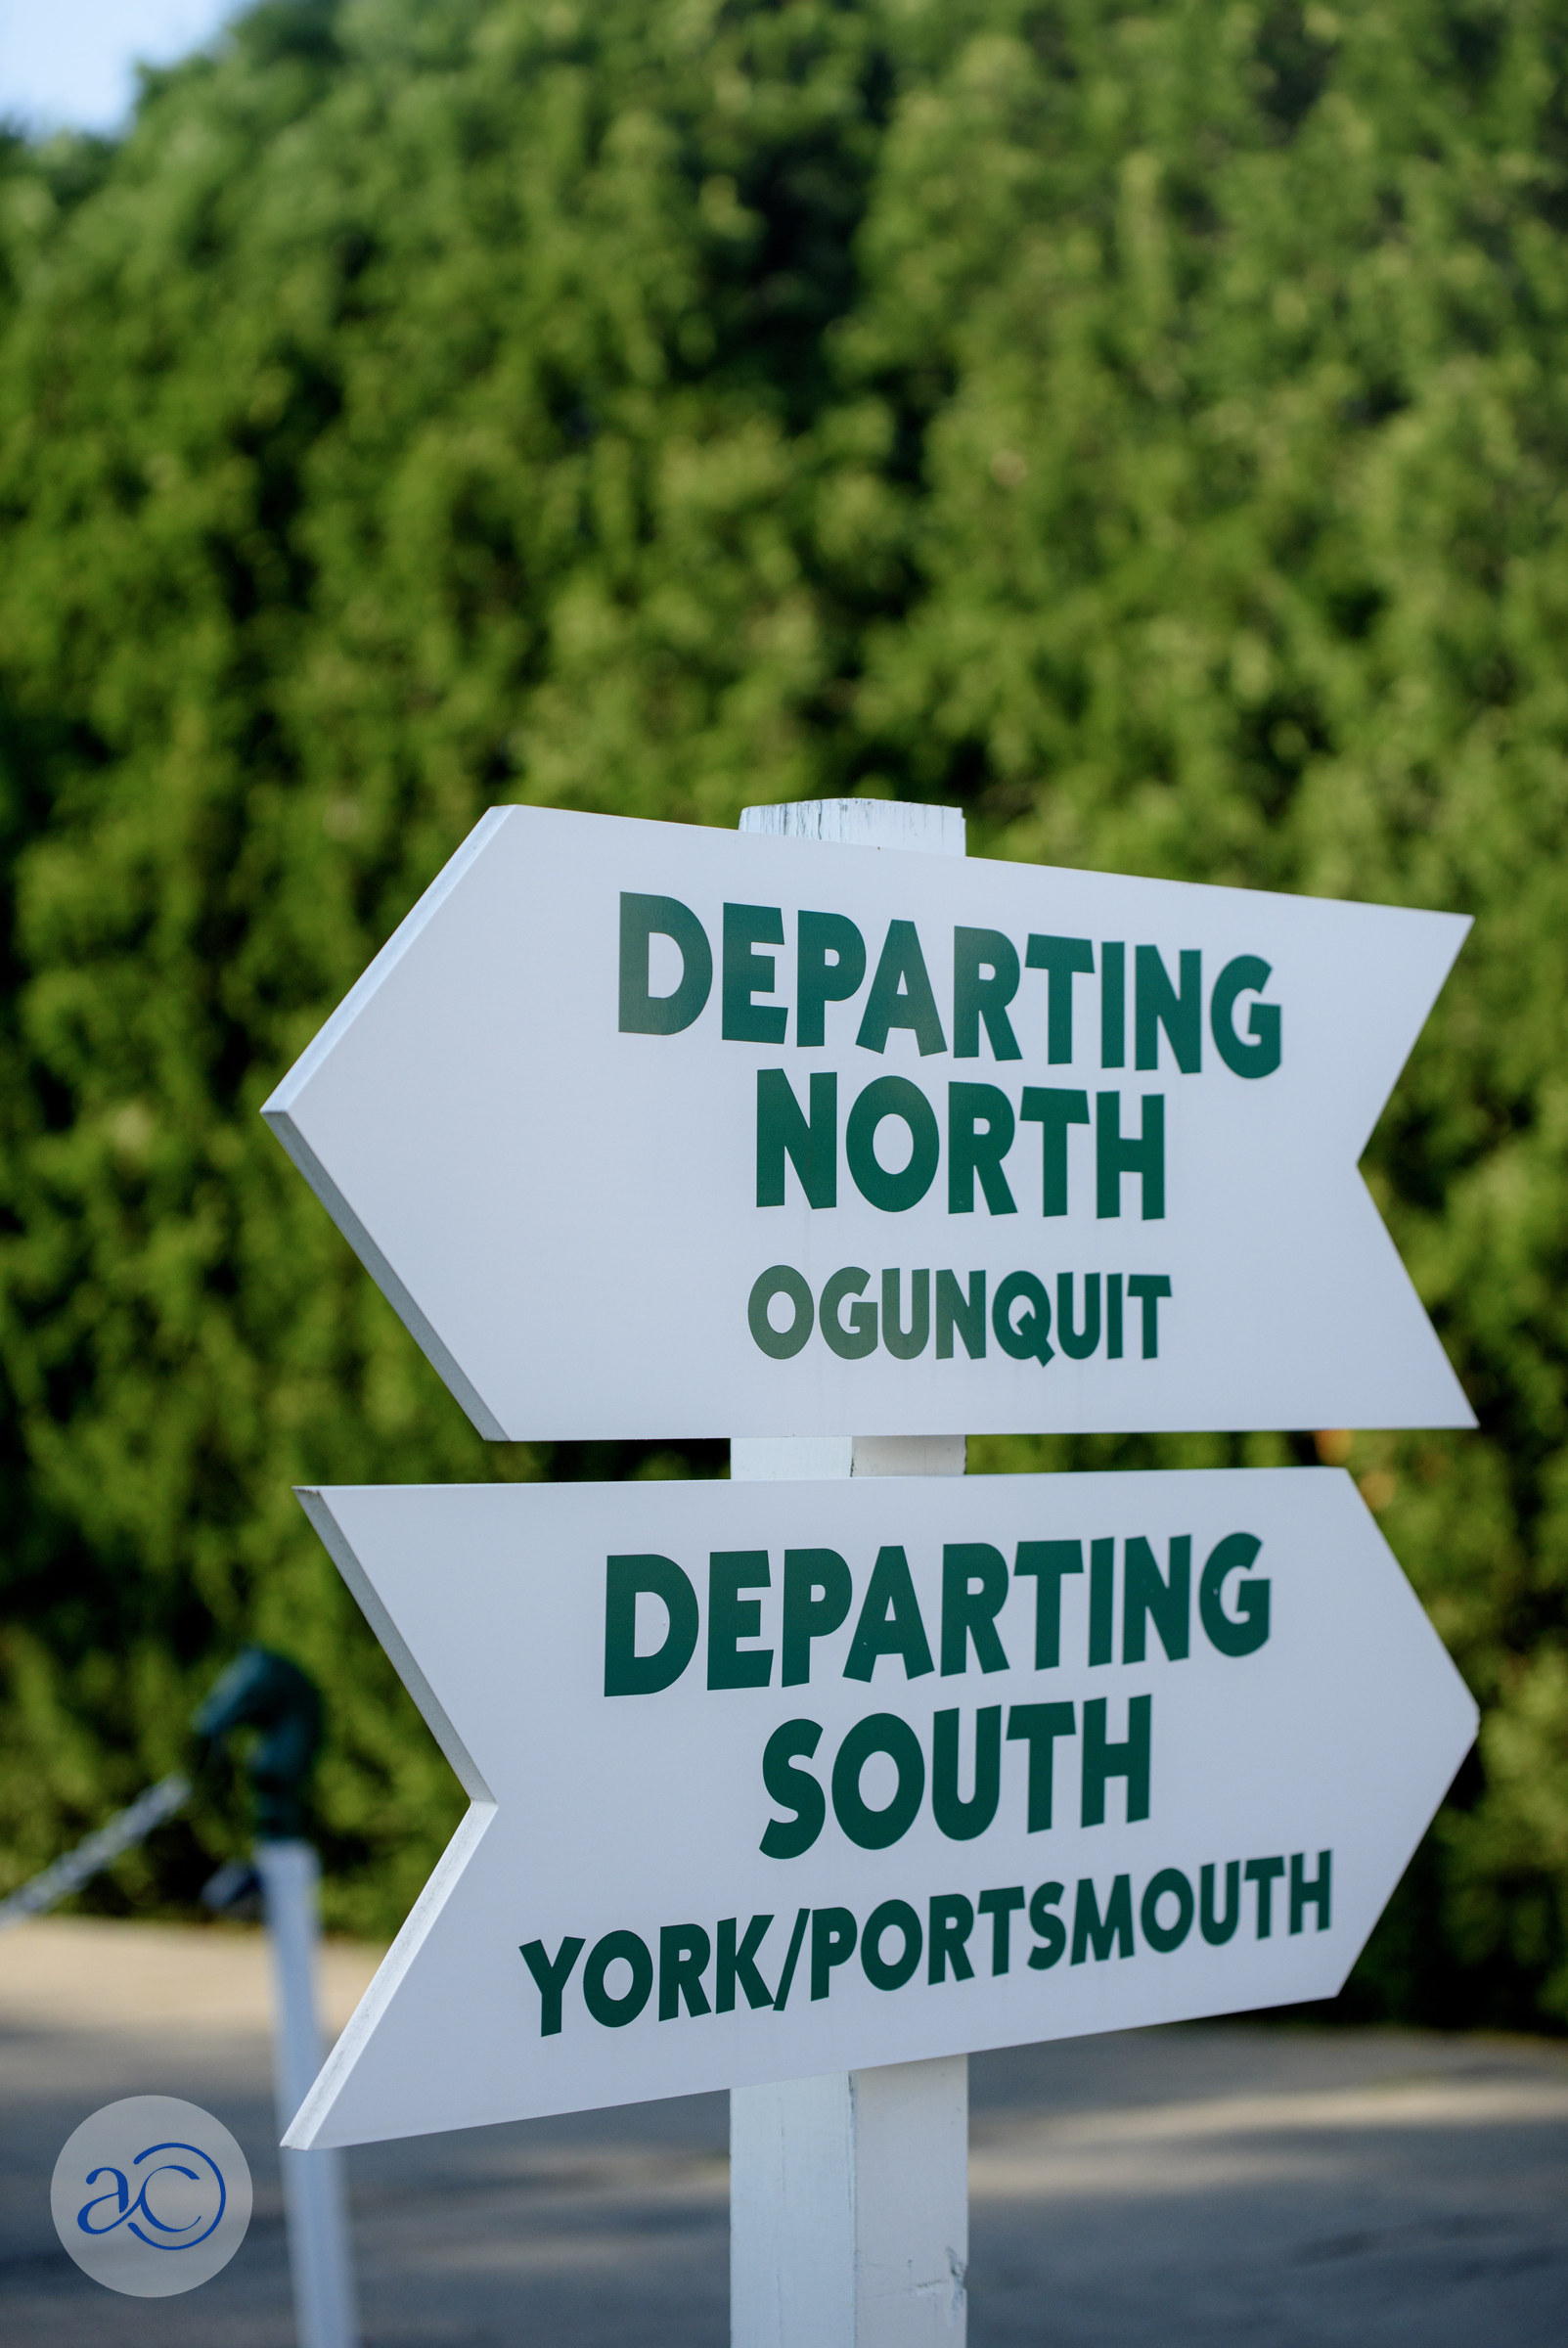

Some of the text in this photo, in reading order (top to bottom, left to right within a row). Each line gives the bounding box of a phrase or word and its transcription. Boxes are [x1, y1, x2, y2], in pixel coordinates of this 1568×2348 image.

[618, 890, 1282, 1080] DEPARTING
[755, 1067, 1166, 1221] NORTH
[746, 1264, 1173, 1369] OGUNQUIT
[603, 1531, 1273, 1698] DEPARTING
[758, 1693, 1153, 1861] SOUTH
[517, 1848, 1333, 2039] YORK/PORTSMOUTH
